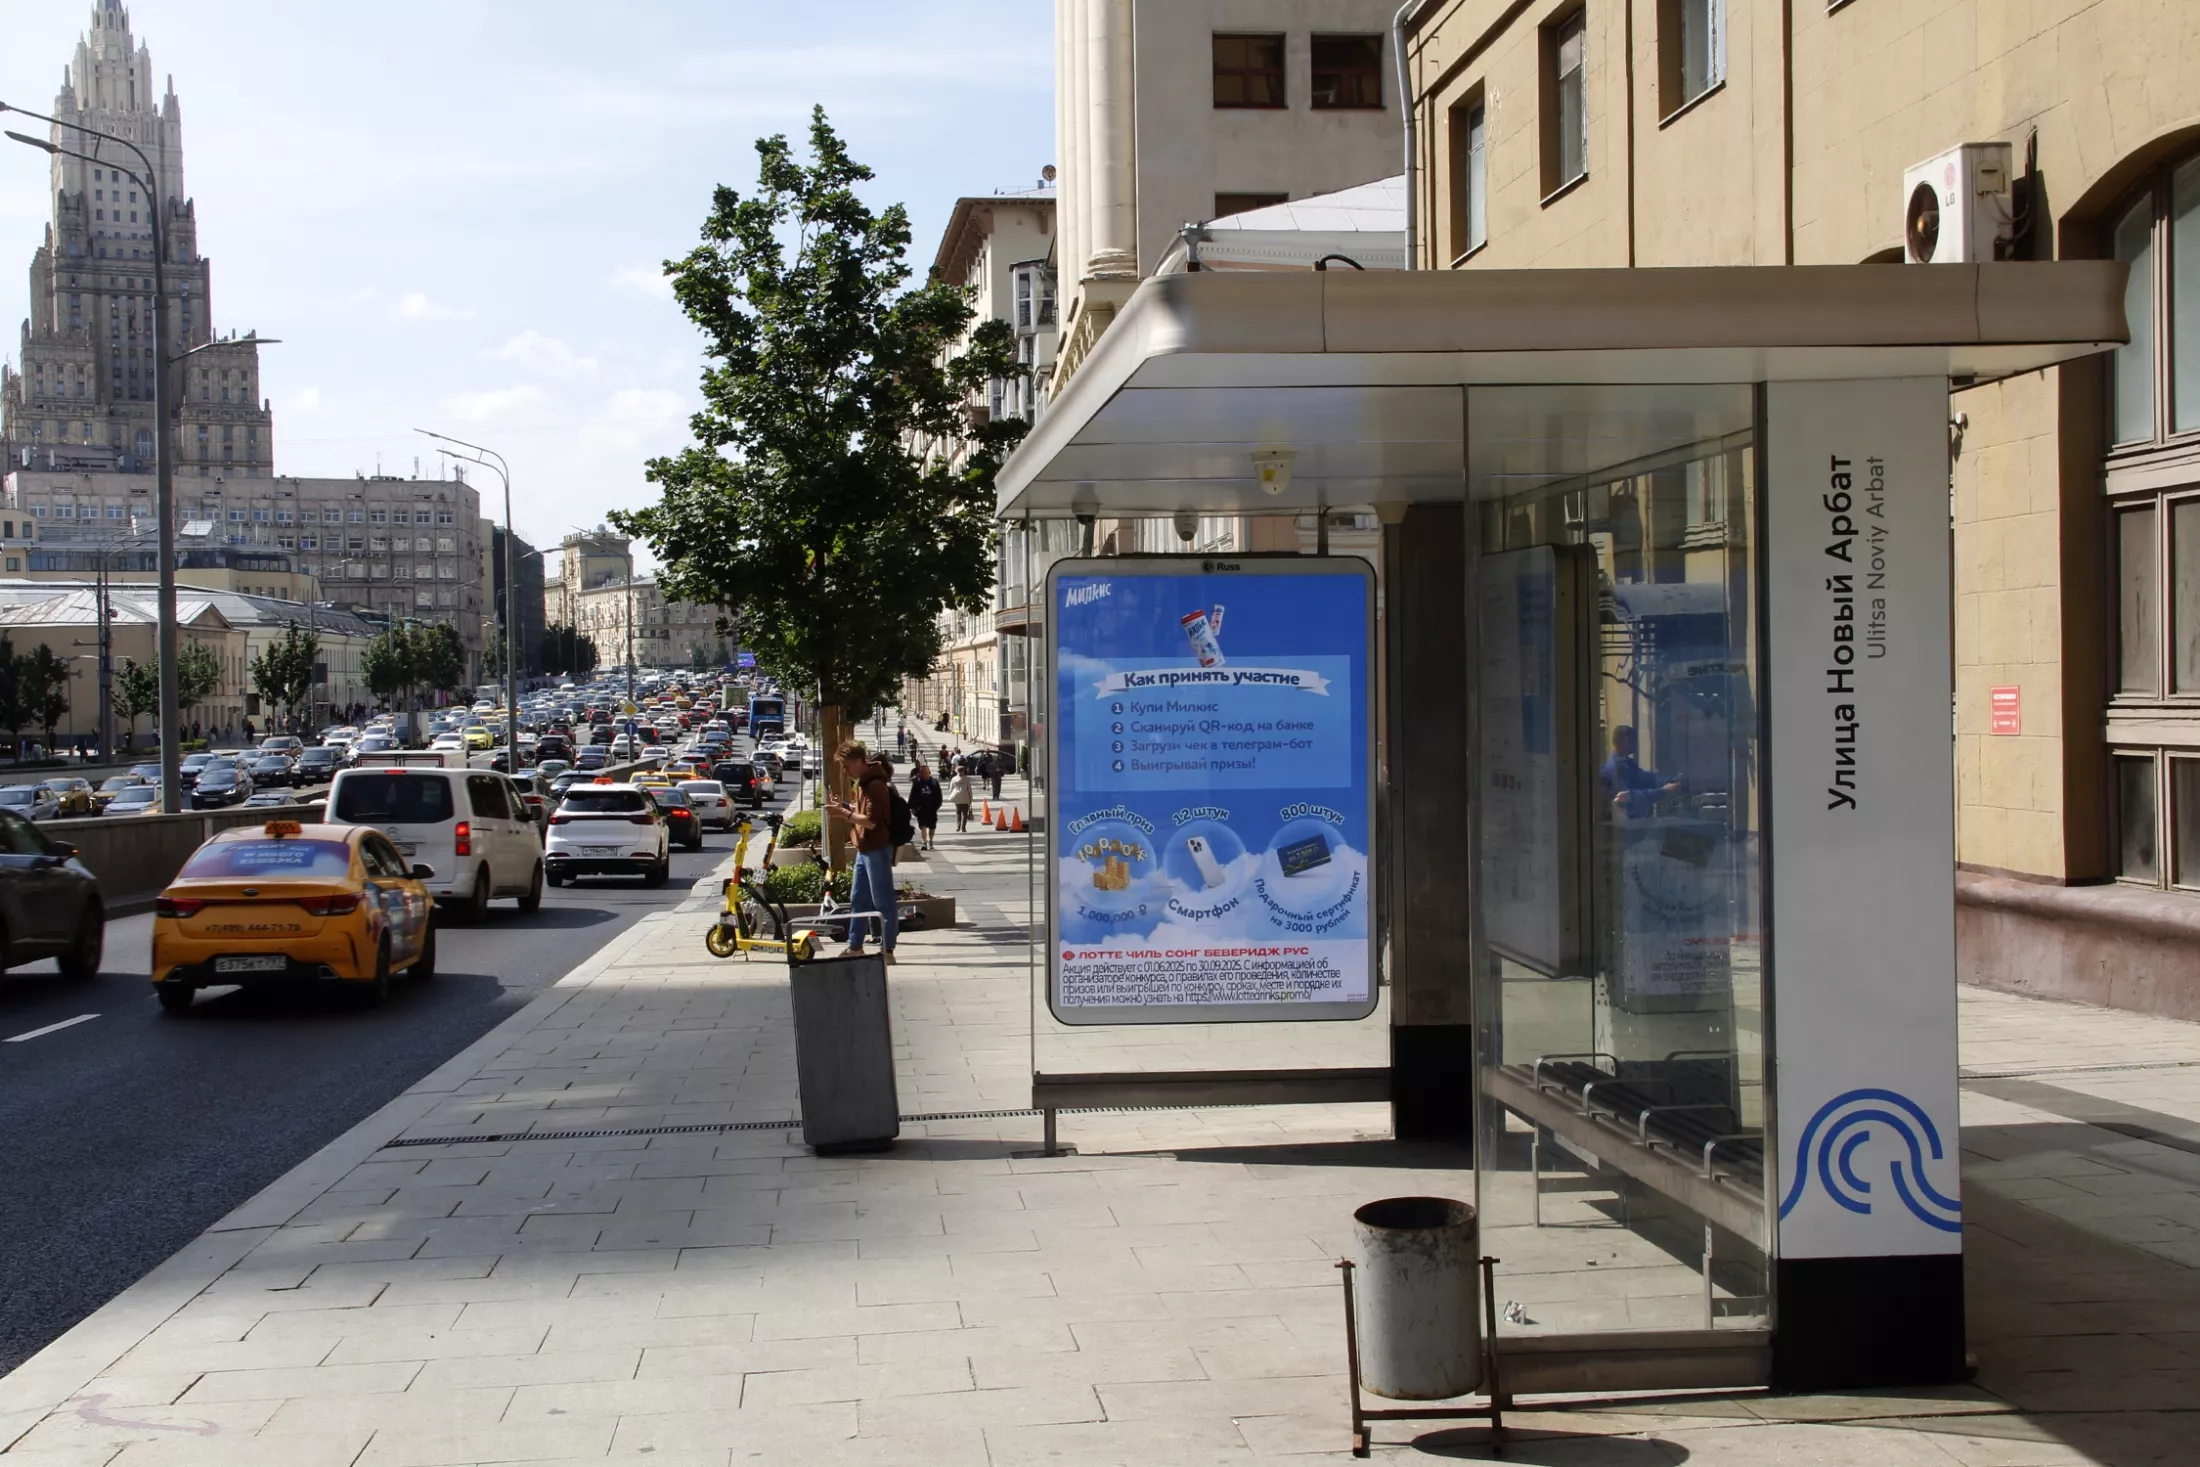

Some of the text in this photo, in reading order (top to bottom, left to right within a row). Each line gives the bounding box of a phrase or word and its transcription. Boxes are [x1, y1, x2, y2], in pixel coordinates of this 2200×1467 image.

[1945, 192, 1956, 207] LG
[1864, 456, 1889, 659] Ulitsa Noviy Arbat
[1216, 562, 1241, 572] Russ
[1822, 455, 1859, 810] Улица Новый Арбат
[1124, 671, 1300, 687] Как принять участие
[1130, 701, 1163, 716] Купи
[1166, 701, 1219, 713] Милкис
[1130, 720, 1195, 736] Сканируй
[1199, 720, 1255, 733] QR-код
[1258, 722, 1272, 731] на
[1276, 719, 1314, 731] банке
[1131, 739, 1181, 755] Загрузи
[1184, 741, 1207, 751] чек
[1210, 741, 1217, 750] в
[1221, 738, 1314, 753] телеграм-бот
[1131, 757, 1207, 773] Выигрывай
[1210, 757, 1256, 770] призы!
[1069, 805, 1154, 834] Главный приз
[1173, 807, 1229, 826] 12 штук
[1280, 803, 1344, 824] 800 штук
[1254, 870, 1360, 922] Подарочный сертификат
[1168, 898, 1240, 921] Смартфон
[1270, 908, 1350, 933] на 3000 рублей
[1079, 947, 1309, 959] ЛОТТЕ ЧИЛЬ СОНГ БЕВЕРИДЖ РУС
[1063, 963, 1091, 975] Акция
[1093, 962, 1136, 976] действует
[1186, 962, 1197, 972] по
[1244, 959, 1250, 970] С
[1251, 957, 1315, 973] информацией
[1317, 957, 1328, 969] об
[1063, 973, 1124, 989] организаторе
[1125, 972, 1168, 986] конкурса,
[1176, 971, 1217, 984] правилах
[1219, 971, 1233, 981] его
[1235, 970, 1290, 983] проведения,
[1291, 968, 1341, 980] количестве
[1063, 984, 1095, 995] призов
[1097, 983, 1114, 993] или
[1171, 982, 1182, 992] по
[1259, 980, 1284, 989] месте
[1293, 979, 1330, 992] порядке
[1332, 979, 1342, 988] их
[1063, 994, 1110, 1007] получения
[1112, 993, 1142, 1004] можно
[1143, 993, 1172, 1005] узнать
[1173, 993, 1184, 1002] на
